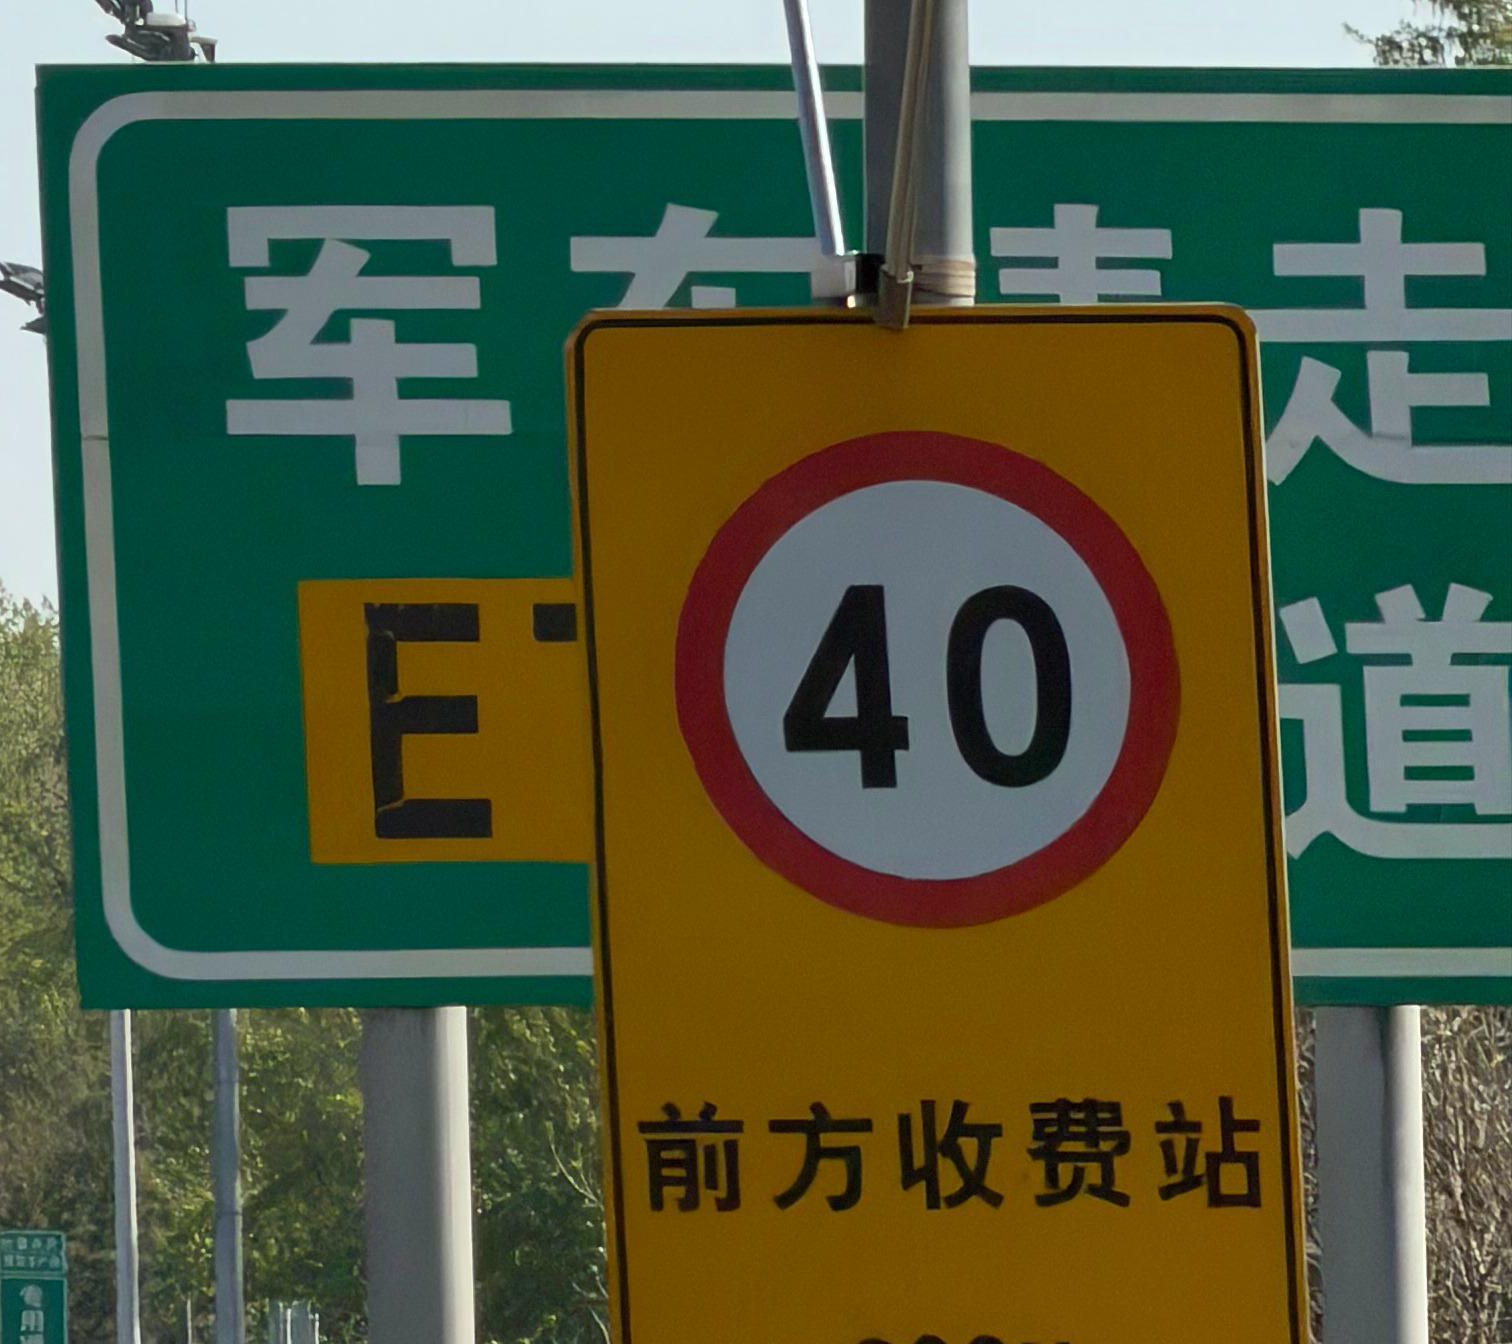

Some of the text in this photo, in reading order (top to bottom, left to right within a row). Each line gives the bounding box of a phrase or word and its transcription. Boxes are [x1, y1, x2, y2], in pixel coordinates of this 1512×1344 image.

[783, 584, 1072, 789] 40
[637, 1096, 1263, 1213] 前方收费站
